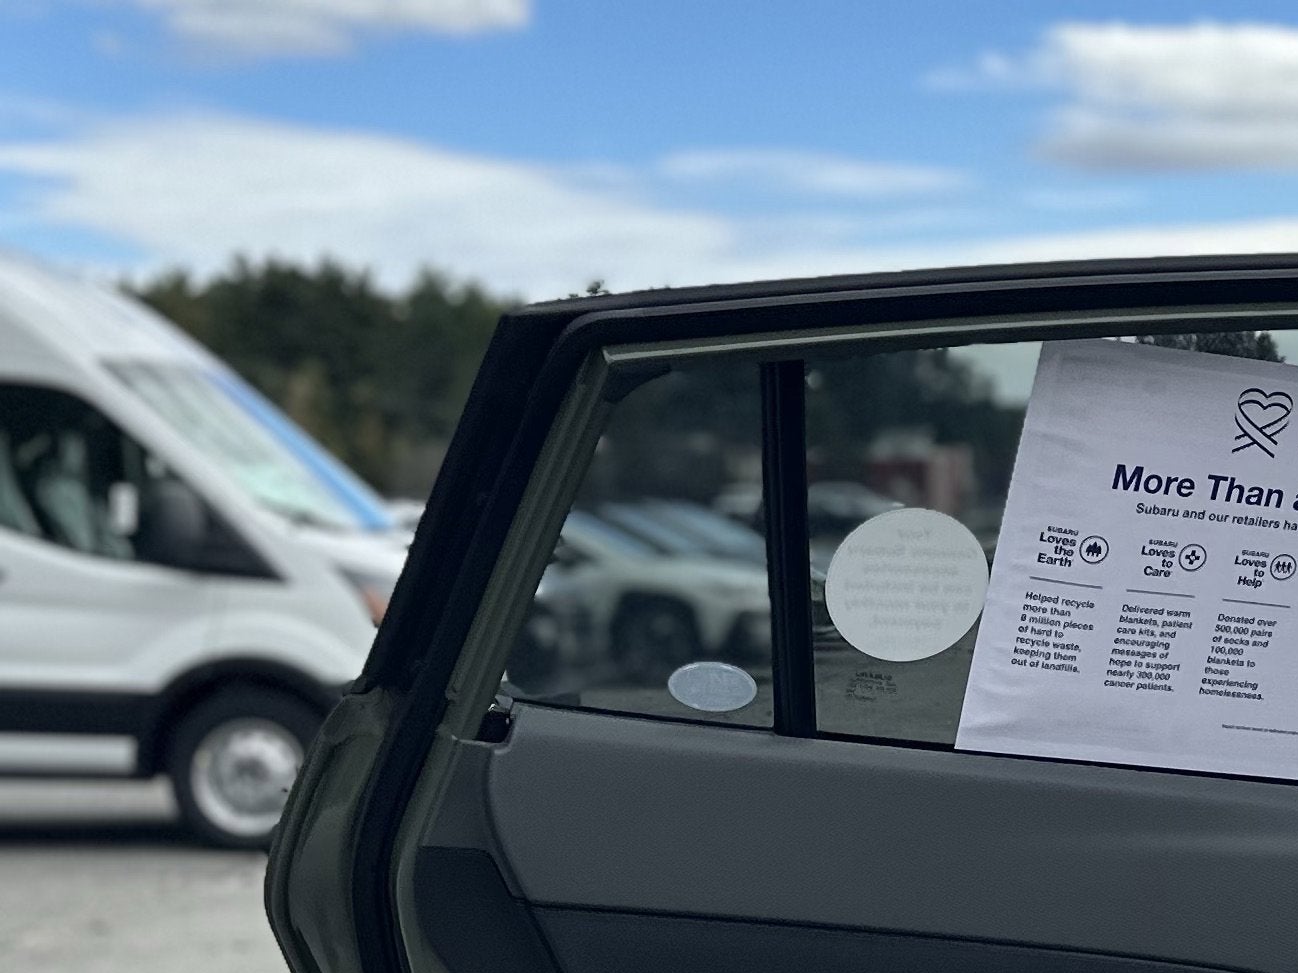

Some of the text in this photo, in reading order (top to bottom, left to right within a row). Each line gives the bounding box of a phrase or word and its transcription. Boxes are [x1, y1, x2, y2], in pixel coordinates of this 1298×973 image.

[1112, 463, 1195, 498] More
[1207, 474, 1284, 509] Than
[1136, 503, 1179, 517] Subaru
[1182, 509, 1205, 520] and
[1208, 513, 1229, 523] our
[1232, 516, 1280, 529] retailers
[1040, 532, 1076, 547] Loves
[1142, 546, 1175, 558] Loves
[1037, 553, 1071, 567] Earth
[1234, 556, 1267, 568] Loves
[1144, 566, 1171, 577] Care
[1237, 576, 1262, 588] Help
